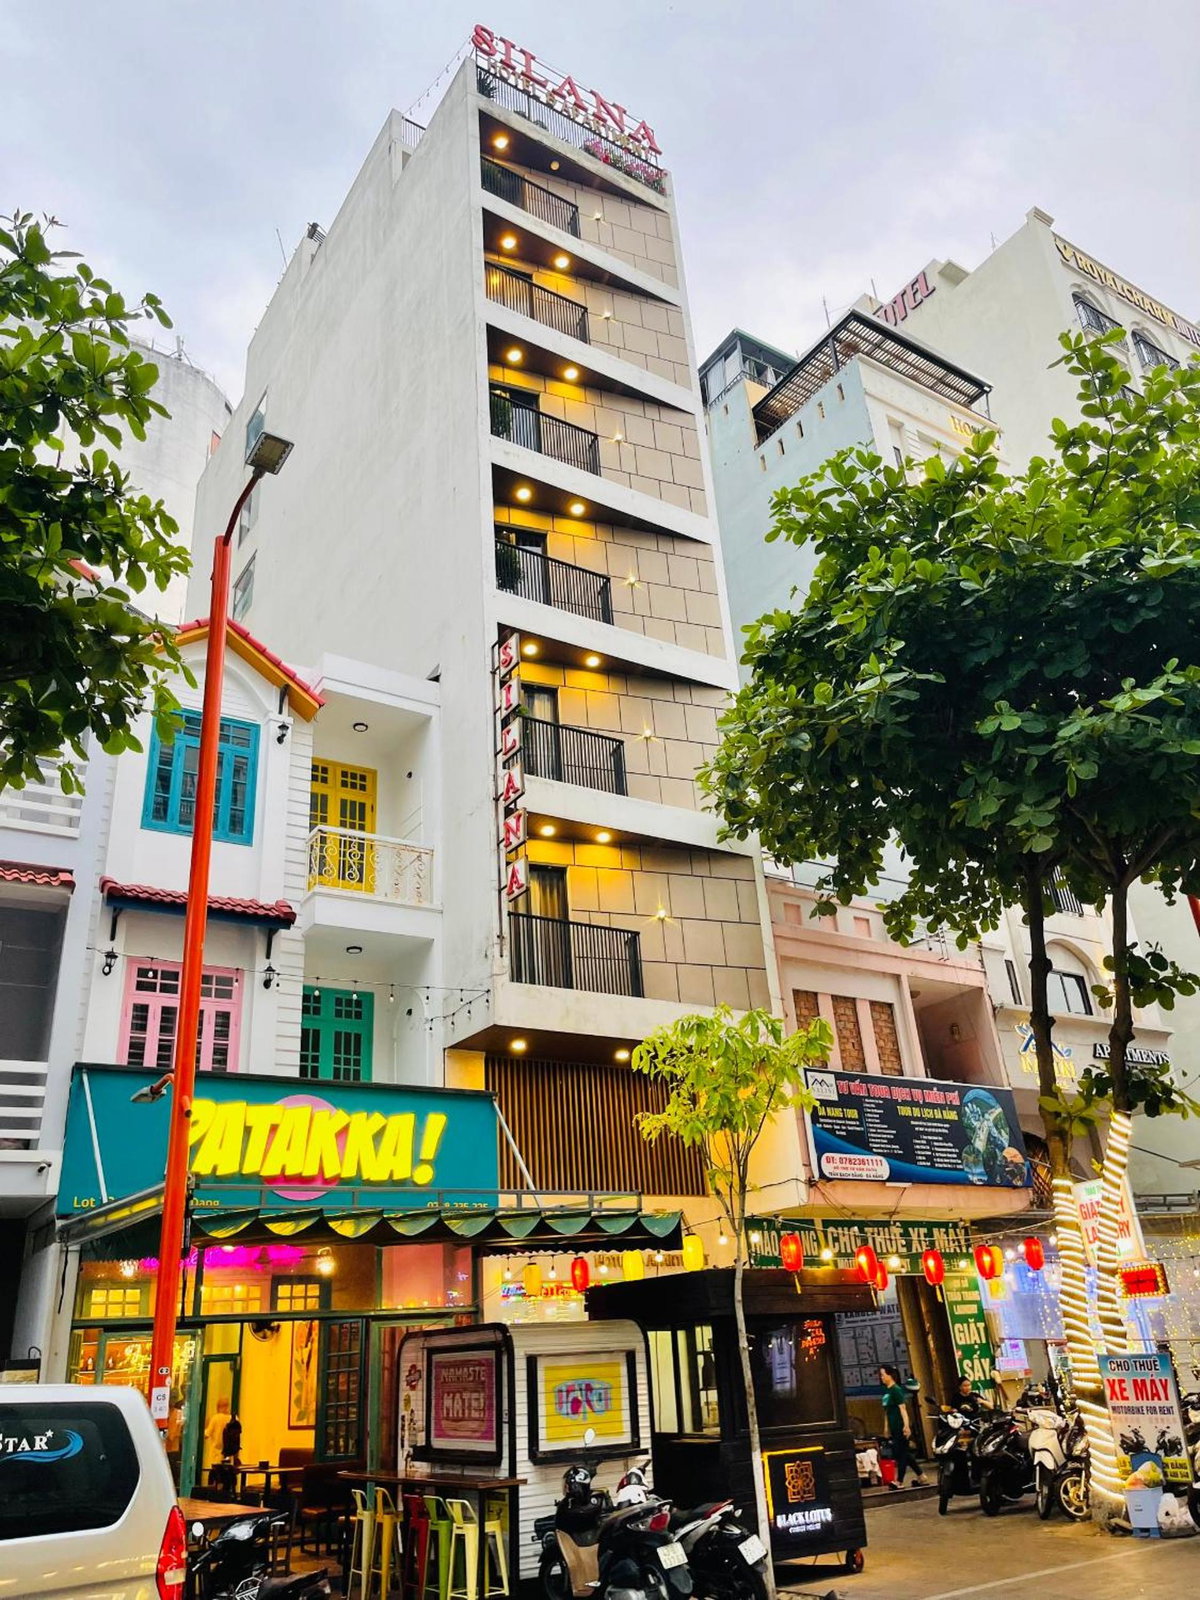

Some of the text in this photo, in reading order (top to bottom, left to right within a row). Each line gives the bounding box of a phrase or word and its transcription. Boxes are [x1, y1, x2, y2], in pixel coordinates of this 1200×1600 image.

[471, 24, 662, 155] SILANA
[500, 641, 525, 896] SILANA
[1095, 1043, 1170, 1065] APTMENTS
[190, 1100, 447, 1185] PATAKKA!
[73, 1196, 97, 1209] Lot
[828, 1226, 862, 1254] CHO
[908, 1227, 931, 1252] XE
[953, 1318, 987, 1349] GIẶT
[441, 1367, 486, 1383] NAMASTE
[962, 1350, 991, 1381] SẤY
[1108, 1357, 1161, 1372] CHO THUÊ
[1106, 1374, 1170, 1401] XE MÁY
[1111, 1406, 1174, 1415] MOTORBIKE FOR RENT
